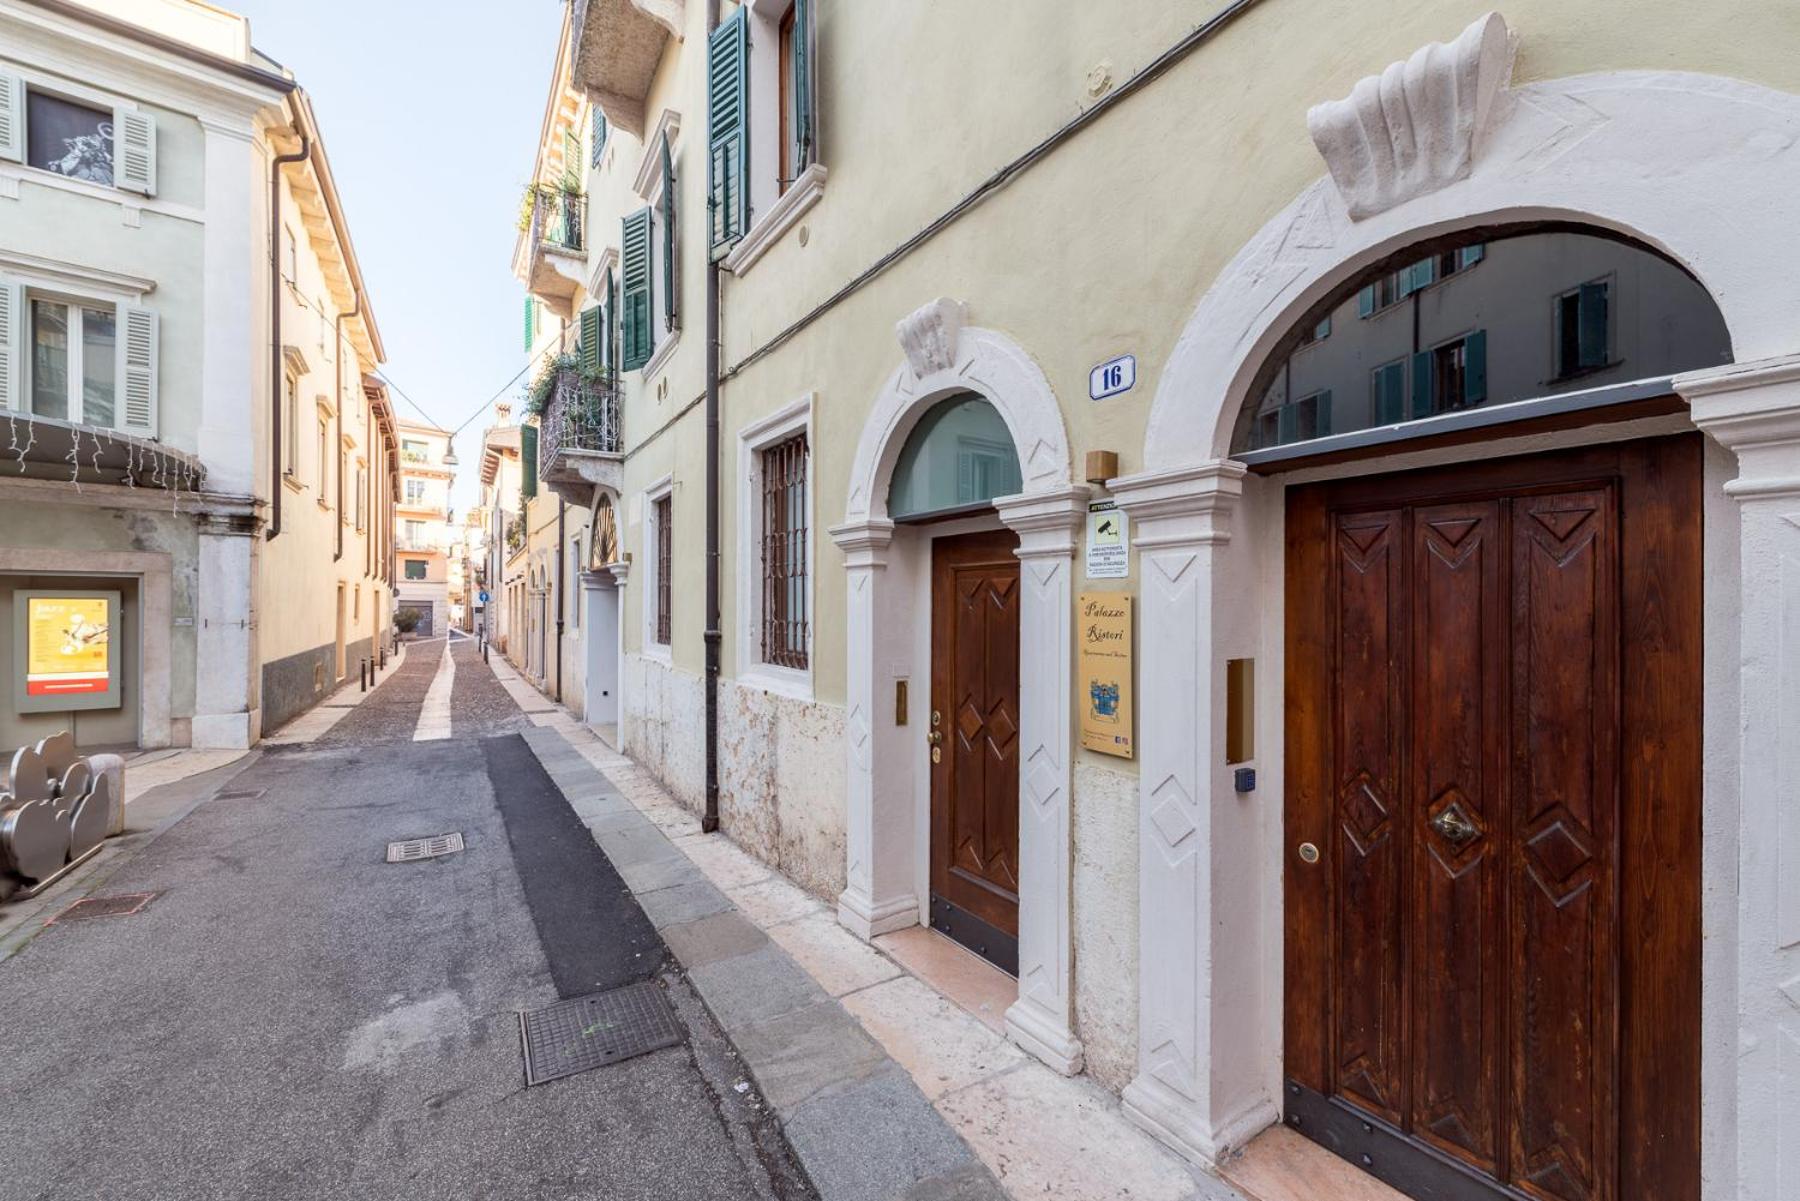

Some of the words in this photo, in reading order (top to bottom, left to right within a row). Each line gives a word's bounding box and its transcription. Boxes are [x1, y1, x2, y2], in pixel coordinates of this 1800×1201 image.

[1104, 365, 1121, 391] 16
[1084, 600, 1125, 618] Palazzo
[1086, 623, 1124, 644] Ristori
